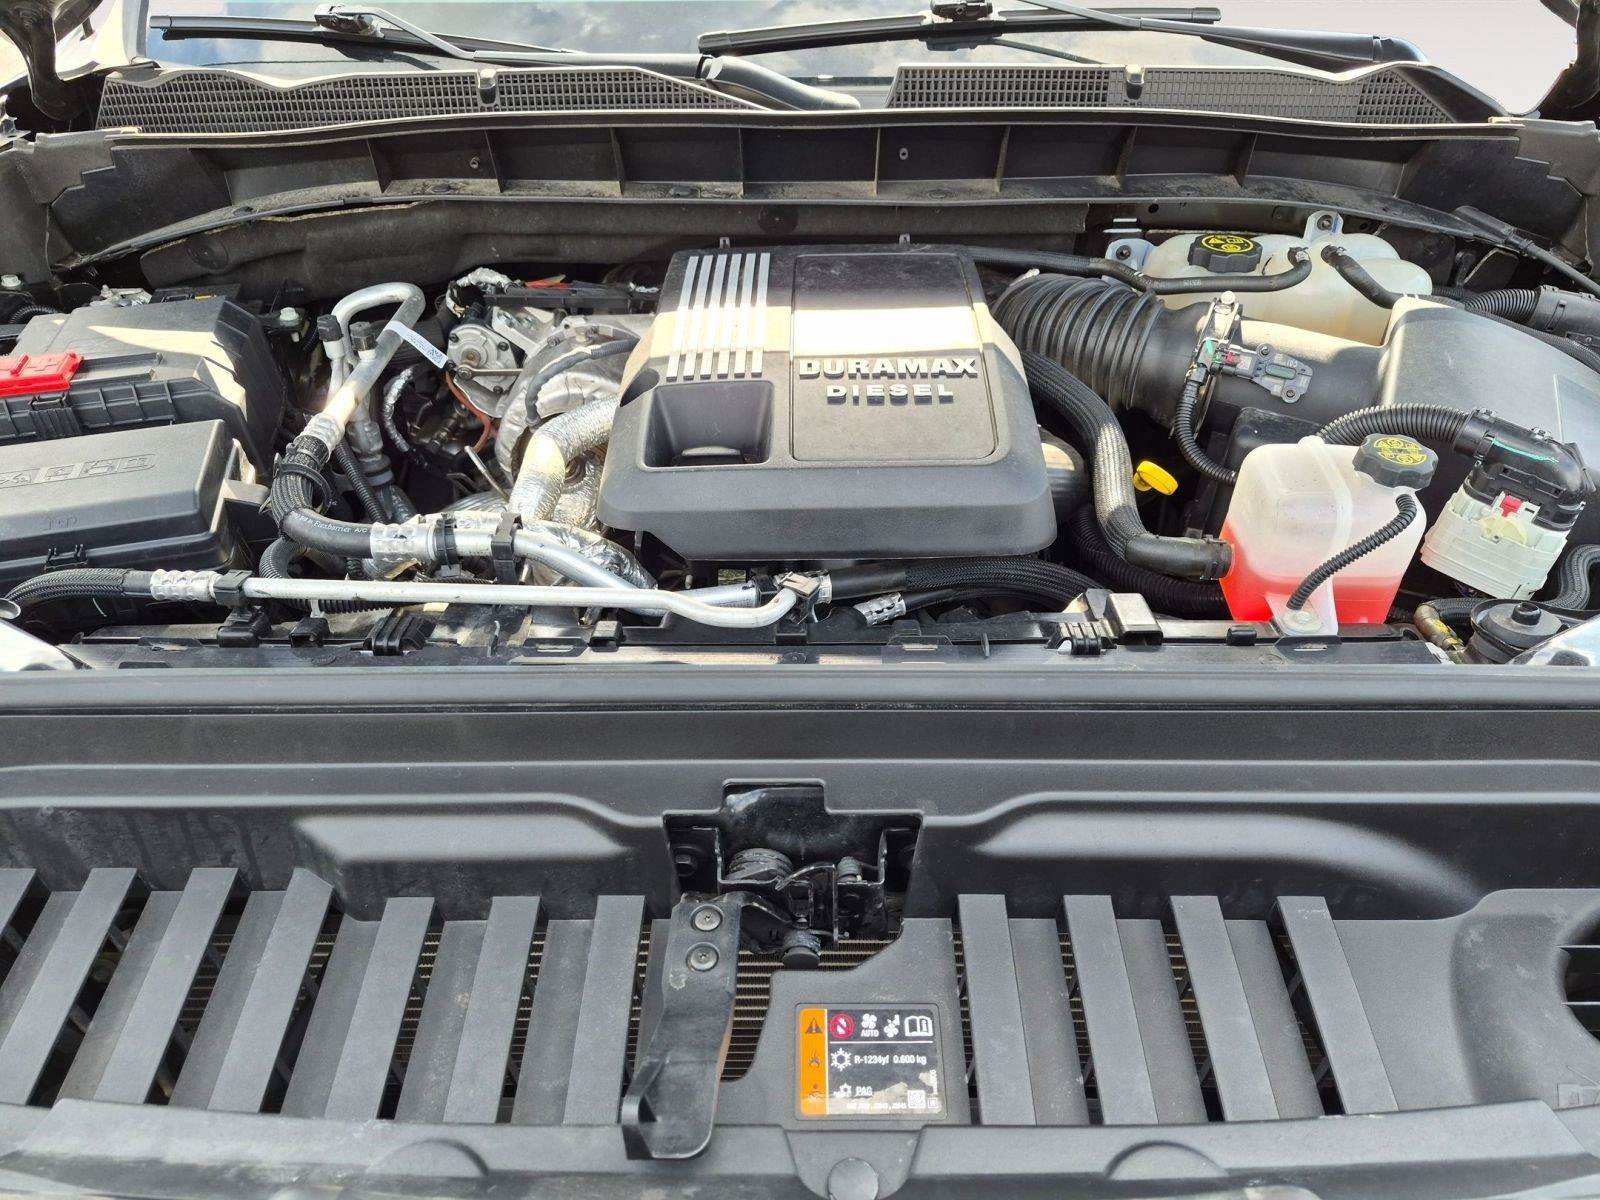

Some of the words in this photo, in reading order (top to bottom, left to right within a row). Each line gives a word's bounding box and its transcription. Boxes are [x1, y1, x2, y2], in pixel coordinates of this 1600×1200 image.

[799, 358, 978, 379] DURAMAX
[826, 384, 954, 405] DIESEL
[860, 1029, 879, 1037] AUTO
[854, 1055, 890, 1066] R-1234yf
[893, 1055, 916, 1064] 0.600
[916, 1055, 927, 1066] kg
[855, 1086, 873, 1096] PAG
